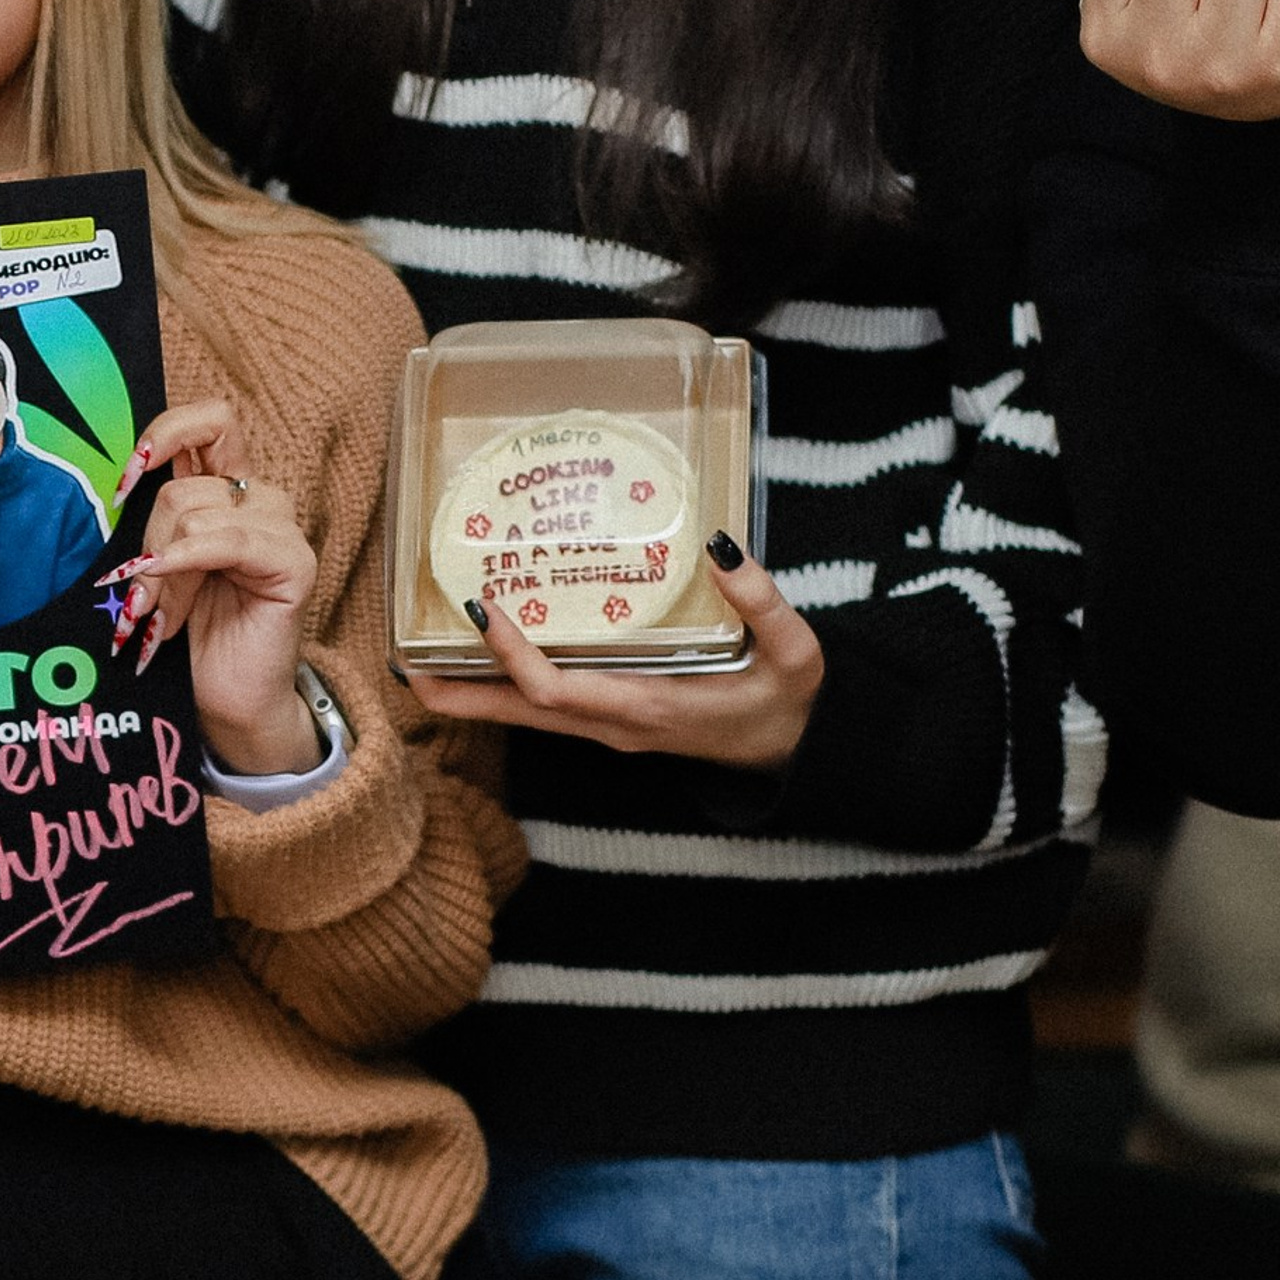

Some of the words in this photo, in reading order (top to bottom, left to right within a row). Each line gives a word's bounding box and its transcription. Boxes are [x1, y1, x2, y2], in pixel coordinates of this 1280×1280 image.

[499, 458, 615, 496] COOKING
[531, 482, 599, 511] LIKE
[506, 523, 524, 542] A
[532, 511, 593, 535] CHEF
[531, 544, 549, 564] A
[482, 575, 541, 600] STAR
